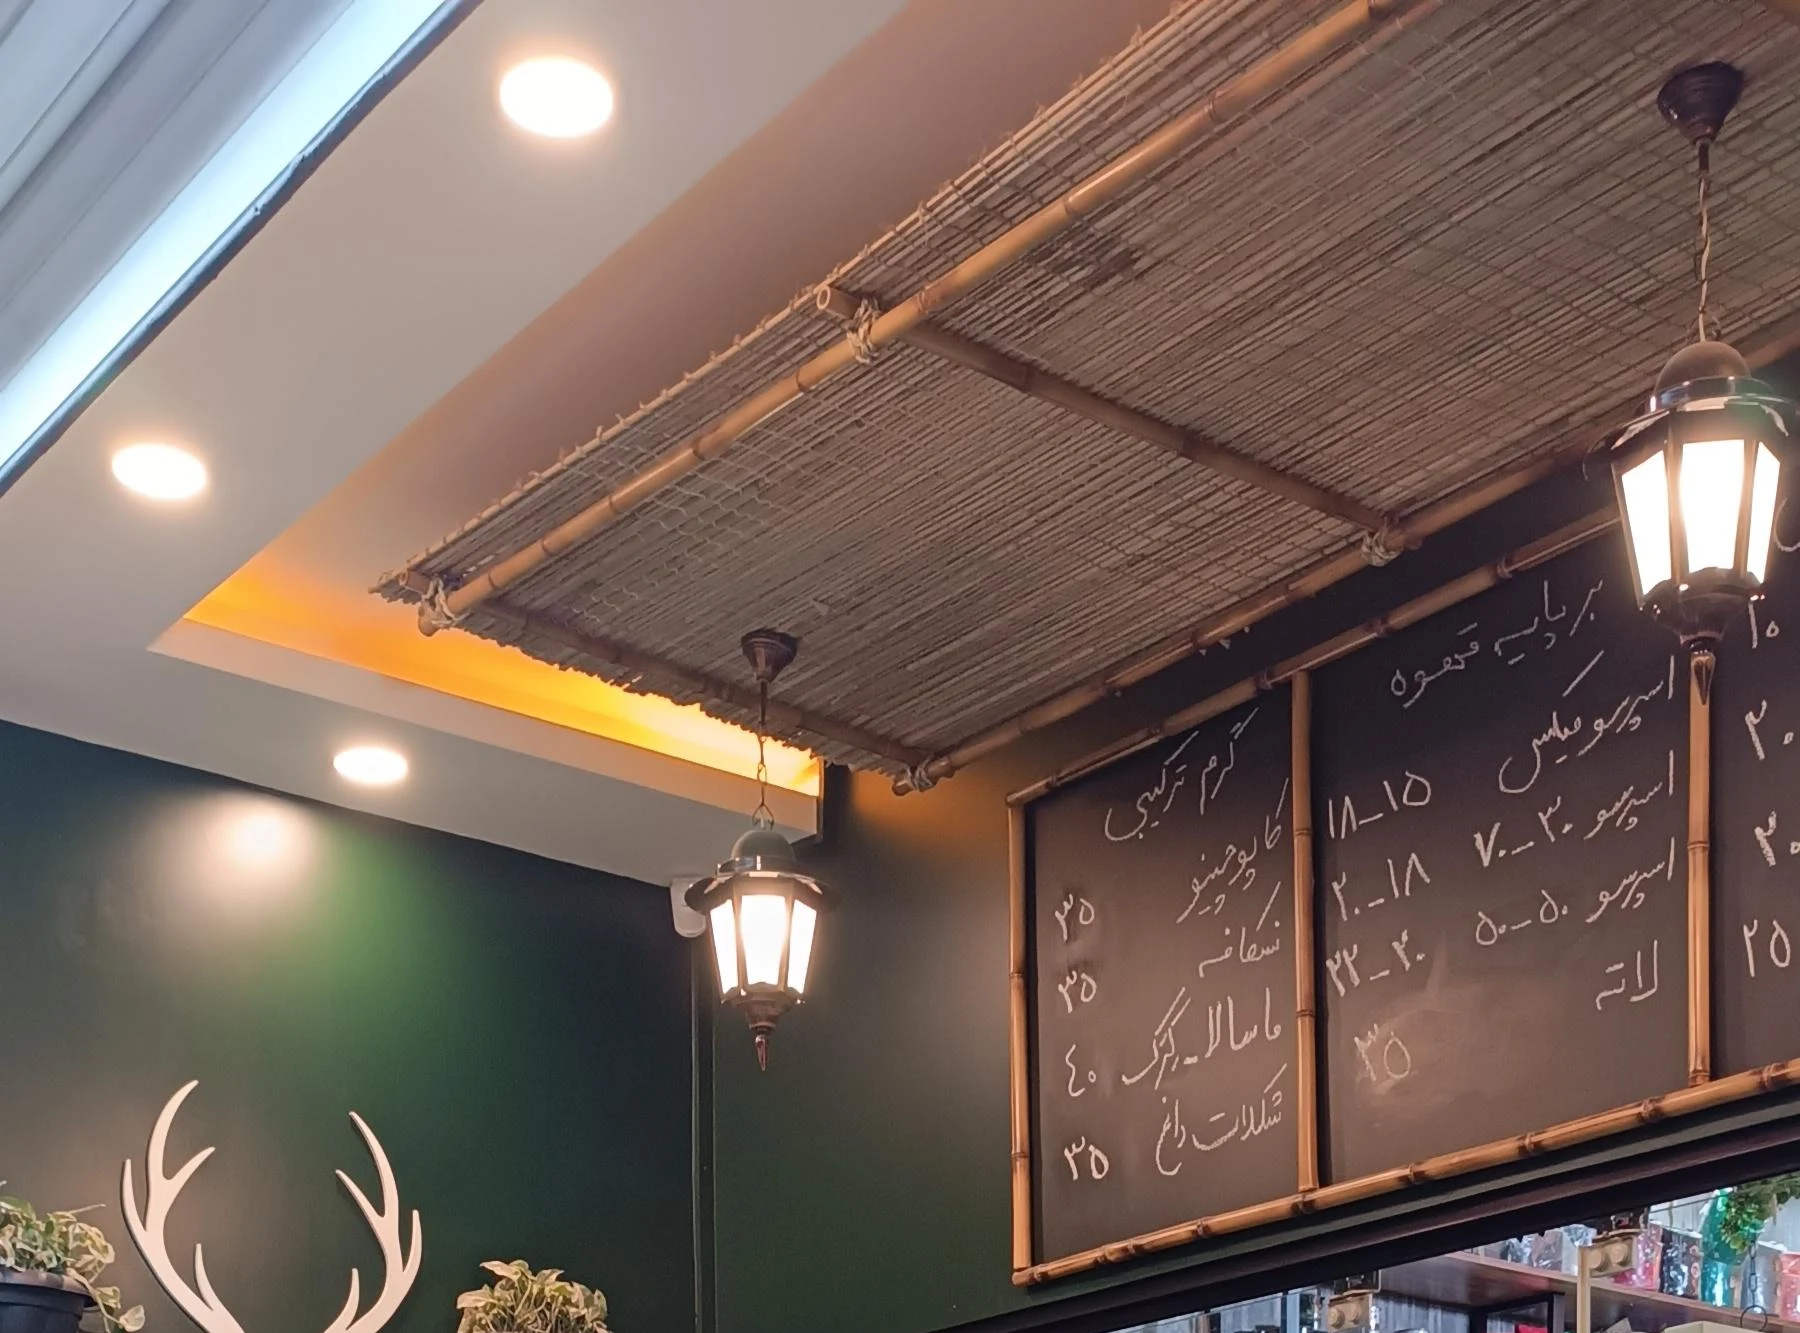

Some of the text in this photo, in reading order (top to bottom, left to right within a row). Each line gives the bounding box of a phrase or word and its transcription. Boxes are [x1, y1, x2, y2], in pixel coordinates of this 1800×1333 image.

[1390, 622, 1480, 709] قهوه
[1104, 707, 1259, 842] گرم ترکیبی
[1054, 777, 1290, 942] کاپوچینو ۳۵
[1057, 880, 1282, 1014] نسکافه ۳۵
[1595, 939, 1659, 1011] لاته
[1742, 918, 1792, 978] ۲۵
[1063, 1135, 1110, 1181] ۳۵
[1155, 1095, 1187, 1177] داغ
